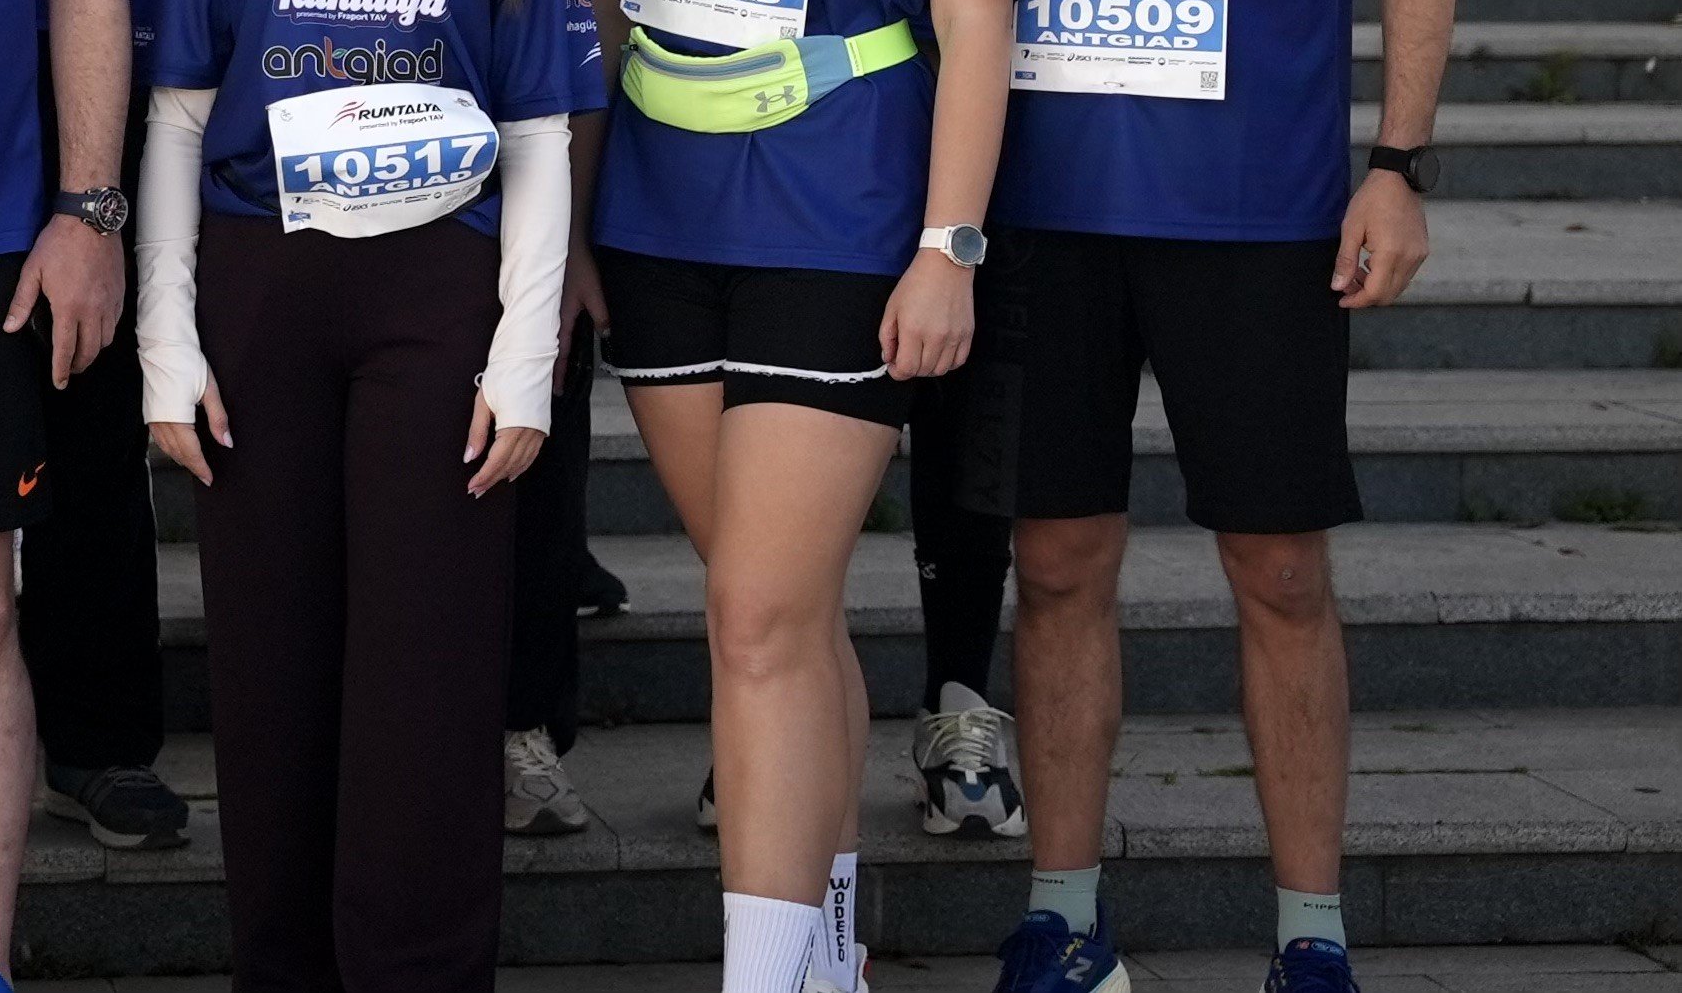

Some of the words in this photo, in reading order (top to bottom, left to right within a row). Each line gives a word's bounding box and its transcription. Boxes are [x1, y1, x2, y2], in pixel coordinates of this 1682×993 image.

[338, 12, 368, 21] Fraport
[370, 13, 387, 21] TAV
[1036, 30, 1198, 49] ANTGIAD
[262, 36, 444, 85] antgiad
[358, 103, 442, 121] RUNTALYA
[295, 134, 488, 184] 10517
[310, 171, 472, 197] ANTGIAD
[829, 877, 851, 962] WODECO
